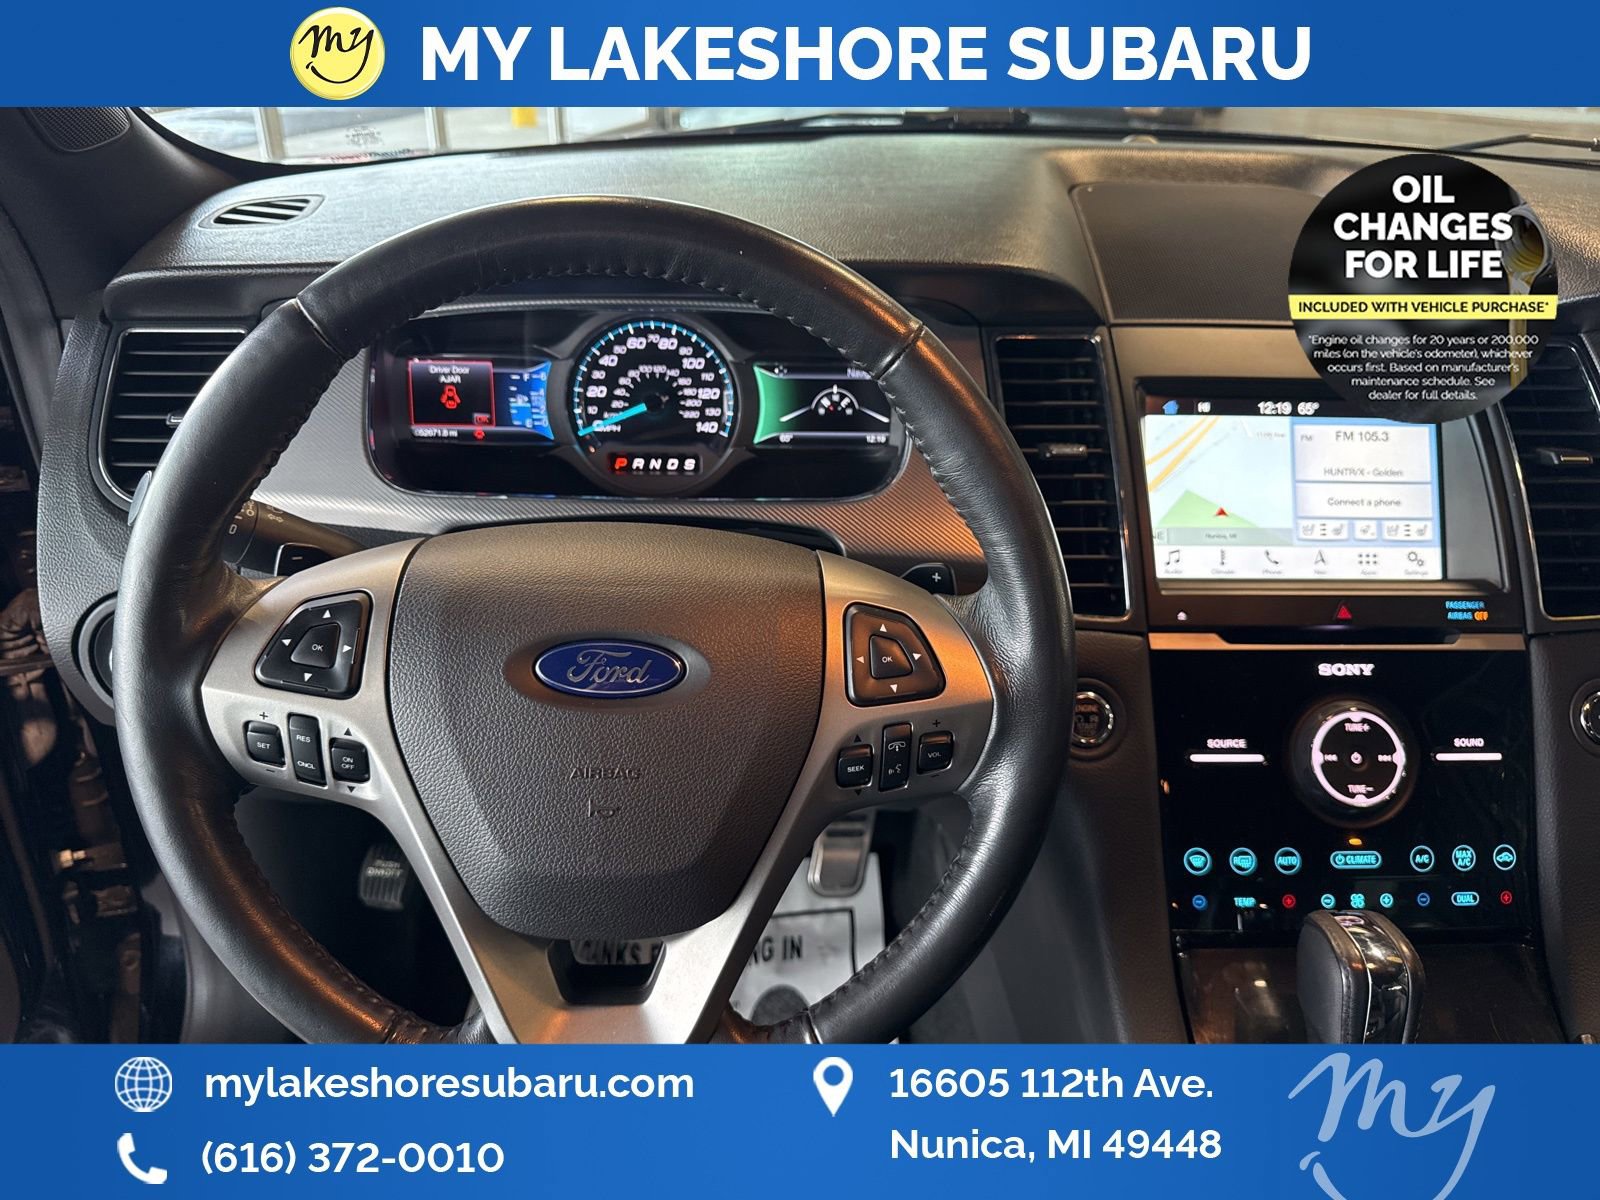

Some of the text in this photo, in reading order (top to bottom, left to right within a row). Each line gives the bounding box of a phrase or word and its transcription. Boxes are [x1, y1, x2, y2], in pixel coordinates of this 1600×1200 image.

[626, 337, 647, 349] 60
[647, 334, 660, 344] 70
[658, 337, 678, 350] 80
[679, 346, 693, 355] 90
[598, 355, 618, 367] 40
[682, 358, 705, 369] 100
[452, 364, 470, 374] Door
[439, 374, 461, 384] AJAR
[591, 370, 606, 379] 30
[701, 372, 715, 381] 110
[586, 386, 607, 398] 20
[698, 388, 720, 400] 120
[587, 406, 598, 414] 10
[705, 407, 721, 416] 130
[1257, 401, 1292, 415] 12:19
[696, 422, 718, 433] 140
[1335, 431, 1389, 442] FM 105.3
[614, 457, 696, 470] P R N D S
[1327, 497, 1364, 507] Connect
[1374, 497, 1402, 508] phone
[311, 643, 324, 652] OK
[881, 656, 893, 664] OK
[566, 649, 652, 684] Ford
[1318, 663, 1375, 676] SONY
[296, 734, 311, 743] RES
[1207, 738, 1247, 749] SOURCE
[1454, 737, 1484, 748] SOUND
[257, 741, 270, 750] SET
[927, 751, 942, 759] VOL
[297, 760, 316, 770] CNCL
[847, 764, 864, 773] SEEK
[570, 767, 641, 780] AIRBAG
[1455, 850, 1472, 858] MAX
[1277, 856, 1298, 866] AUTO
[1346, 855, 1377, 865] CLIMATE
[1415, 855, 1430, 864] A/C
[1457, 858, 1471, 866] A/C
[1234, 896, 1257, 908] TEMP
[1456, 894, 1475, 904] DUAL
[783, 935, 802, 960] IN
